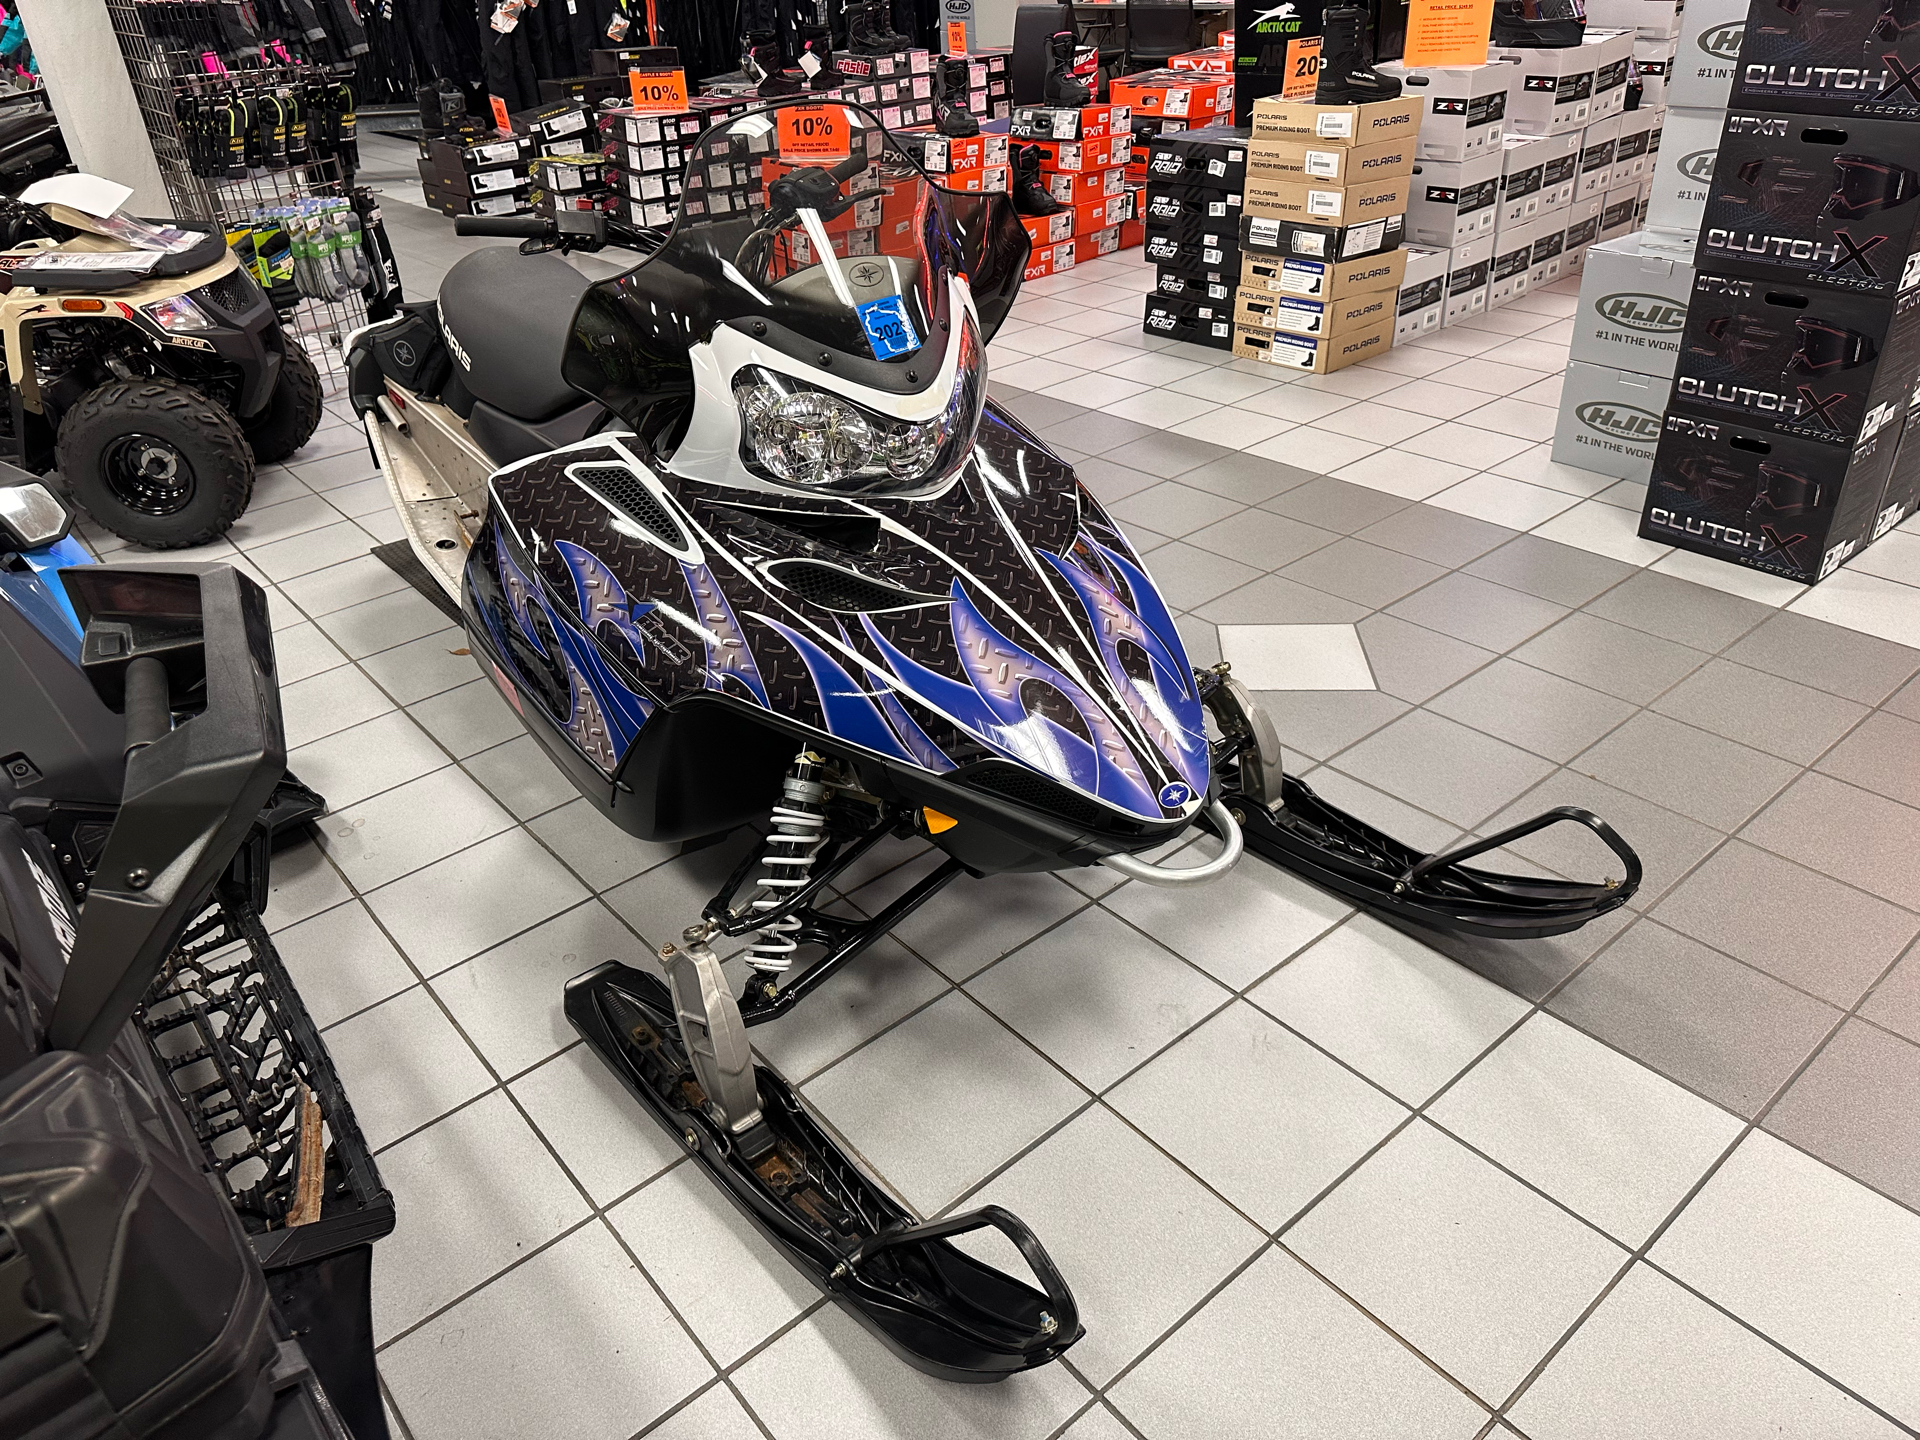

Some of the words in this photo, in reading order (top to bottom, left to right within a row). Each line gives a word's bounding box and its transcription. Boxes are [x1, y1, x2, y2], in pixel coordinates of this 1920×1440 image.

[1256, 22, 1284, 33] ARCTIC
[1285, 22, 1300, 32] CAT
[1295, 56, 1318, 77] 20
[1697, 68, 1712, 78] #1
[1714, 68, 1728, 78] IN
[1352, 71, 1376, 80] POLARIS
[1744, 64, 1889, 90] CLUTCH
[1870, 56, 1920, 102] X
[640, 85, 678, 101] 10%
[1852, 104, 1920, 116] ELECTR
[792, 117, 832, 136] 10%
[1373, 114, 1410, 128] POLARIS
[1737, 118, 1789, 136] FXR
[1010, 125, 1030, 136] FXR
[1083, 125, 1104, 137] FXR
[953, 157, 976, 170] FXR
[1150, 160, 1182, 174] RAID
[1362, 154, 1402, 169] POLARIS
[1359, 193, 1396, 207] POLARIS
[1677, 190, 1693, 200] #1
[1694, 191, 1705, 201] IN
[1149, 203, 1180, 217] RAID
[1252, 225, 1278, 233] POLARIS
[1147, 244, 1178, 258] RAID
[1706, 228, 1840, 263] CLUTCH
[1823, 230, 1888, 279] X
[1245, 255, 1279, 266] POLARIS
[1285, 262, 1300, 270] PREMIUM
[1024, 265, 1046, 278] FXR
[1348, 266, 1390, 283] POLARIS
[1159, 280, 1184, 293] RAID
[1706, 276, 1753, 297] FXR
[1806, 273, 1885, 290] ELECTRIC
[1240, 292, 1275, 303] POLARIS
[1346, 302, 1383, 320] POLARIS
[1608, 299, 1687, 327] HJC
[1146, 316, 1176, 330] RAID
[1627, 320, 1664, 329] HELMETS
[1238, 326, 1272, 338] POLARIS
[172, 337, 193, 346] ARCTIC
[1275, 336, 1291, 344] PREMIUM
[1343, 335, 1380, 354] POLARIS
[1596, 330, 1608, 340] #1
[1611, 334, 1622, 342] IN
[1624, 335, 1645, 347] THE
[1648, 339, 1680, 352] WORL
[1678, 376, 1803, 415] CLUTCH
[1789, 386, 1848, 433] X
[1586, 407, 1662, 438] HJC
[1675, 417, 1720, 441] FXR
[1606, 427, 1640, 438] HELMETS
[1774, 423, 1845, 443] ELECTRIC
[1576, 434, 1589, 444] #1
[1591, 438, 1602, 448] IN
[1602, 440, 1623, 453] THE
[1626, 446, 1657, 461] WORL
[1650, 507, 1766, 551] CLUTCH
[1753, 525, 1808, 570] X
[1739, 556, 1806, 579] ELECTRIC
